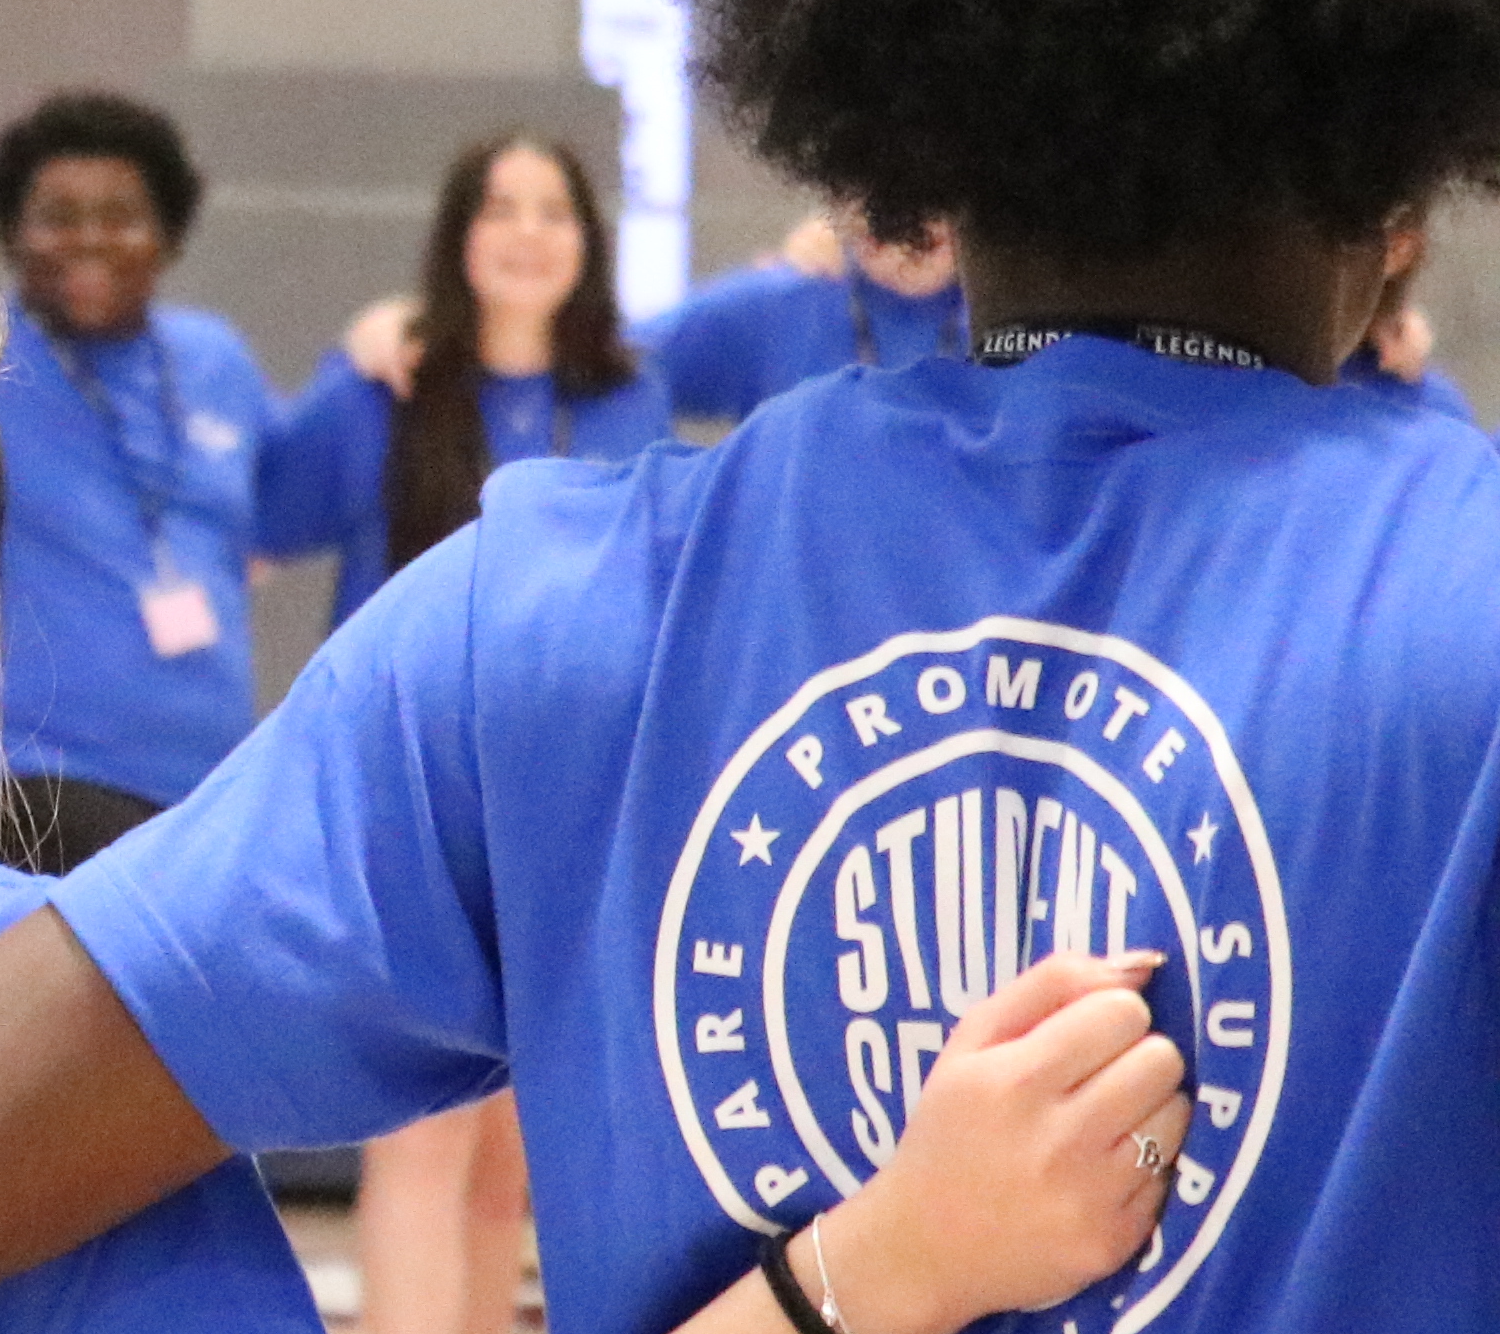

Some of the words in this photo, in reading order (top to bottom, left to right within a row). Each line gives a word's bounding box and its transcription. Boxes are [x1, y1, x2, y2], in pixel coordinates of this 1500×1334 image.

[1154, 336, 1265, 369] LEGENDS
[785, 654, 1187, 790] PROMOTE
[835, 787, 1138, 1018] STUDENT
[692, 940, 810, 1207] PARE
